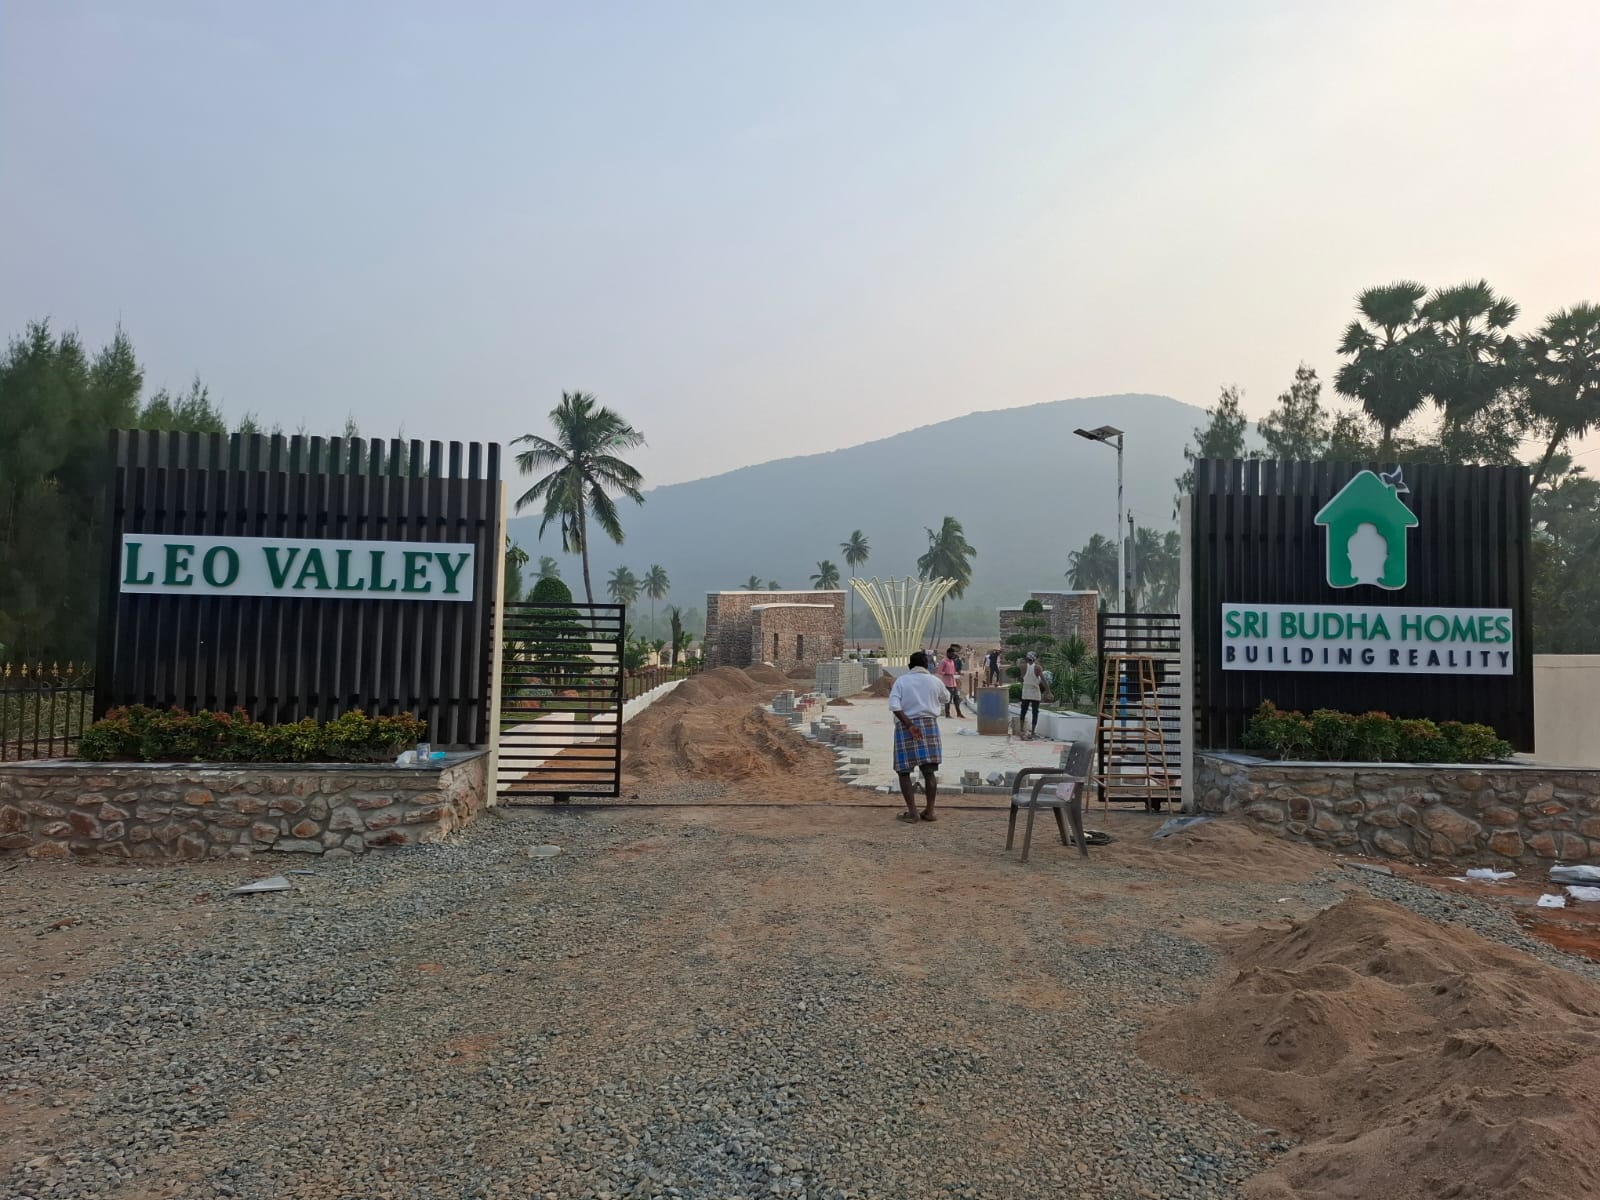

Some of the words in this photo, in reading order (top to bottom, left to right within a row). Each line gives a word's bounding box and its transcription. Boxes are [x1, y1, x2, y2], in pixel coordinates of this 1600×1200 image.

[123, 542, 240, 587] LEO
[262, 547, 471, 594] VALLEY
[1225, 610, 1268, 639] SRI
[1280, 612, 1391, 641] BUDHA
[1401, 614, 1511, 644] HOMES
[1226, 645, 1375, 666] BUILDING
[1389, 648, 1510, 668] REALITY
